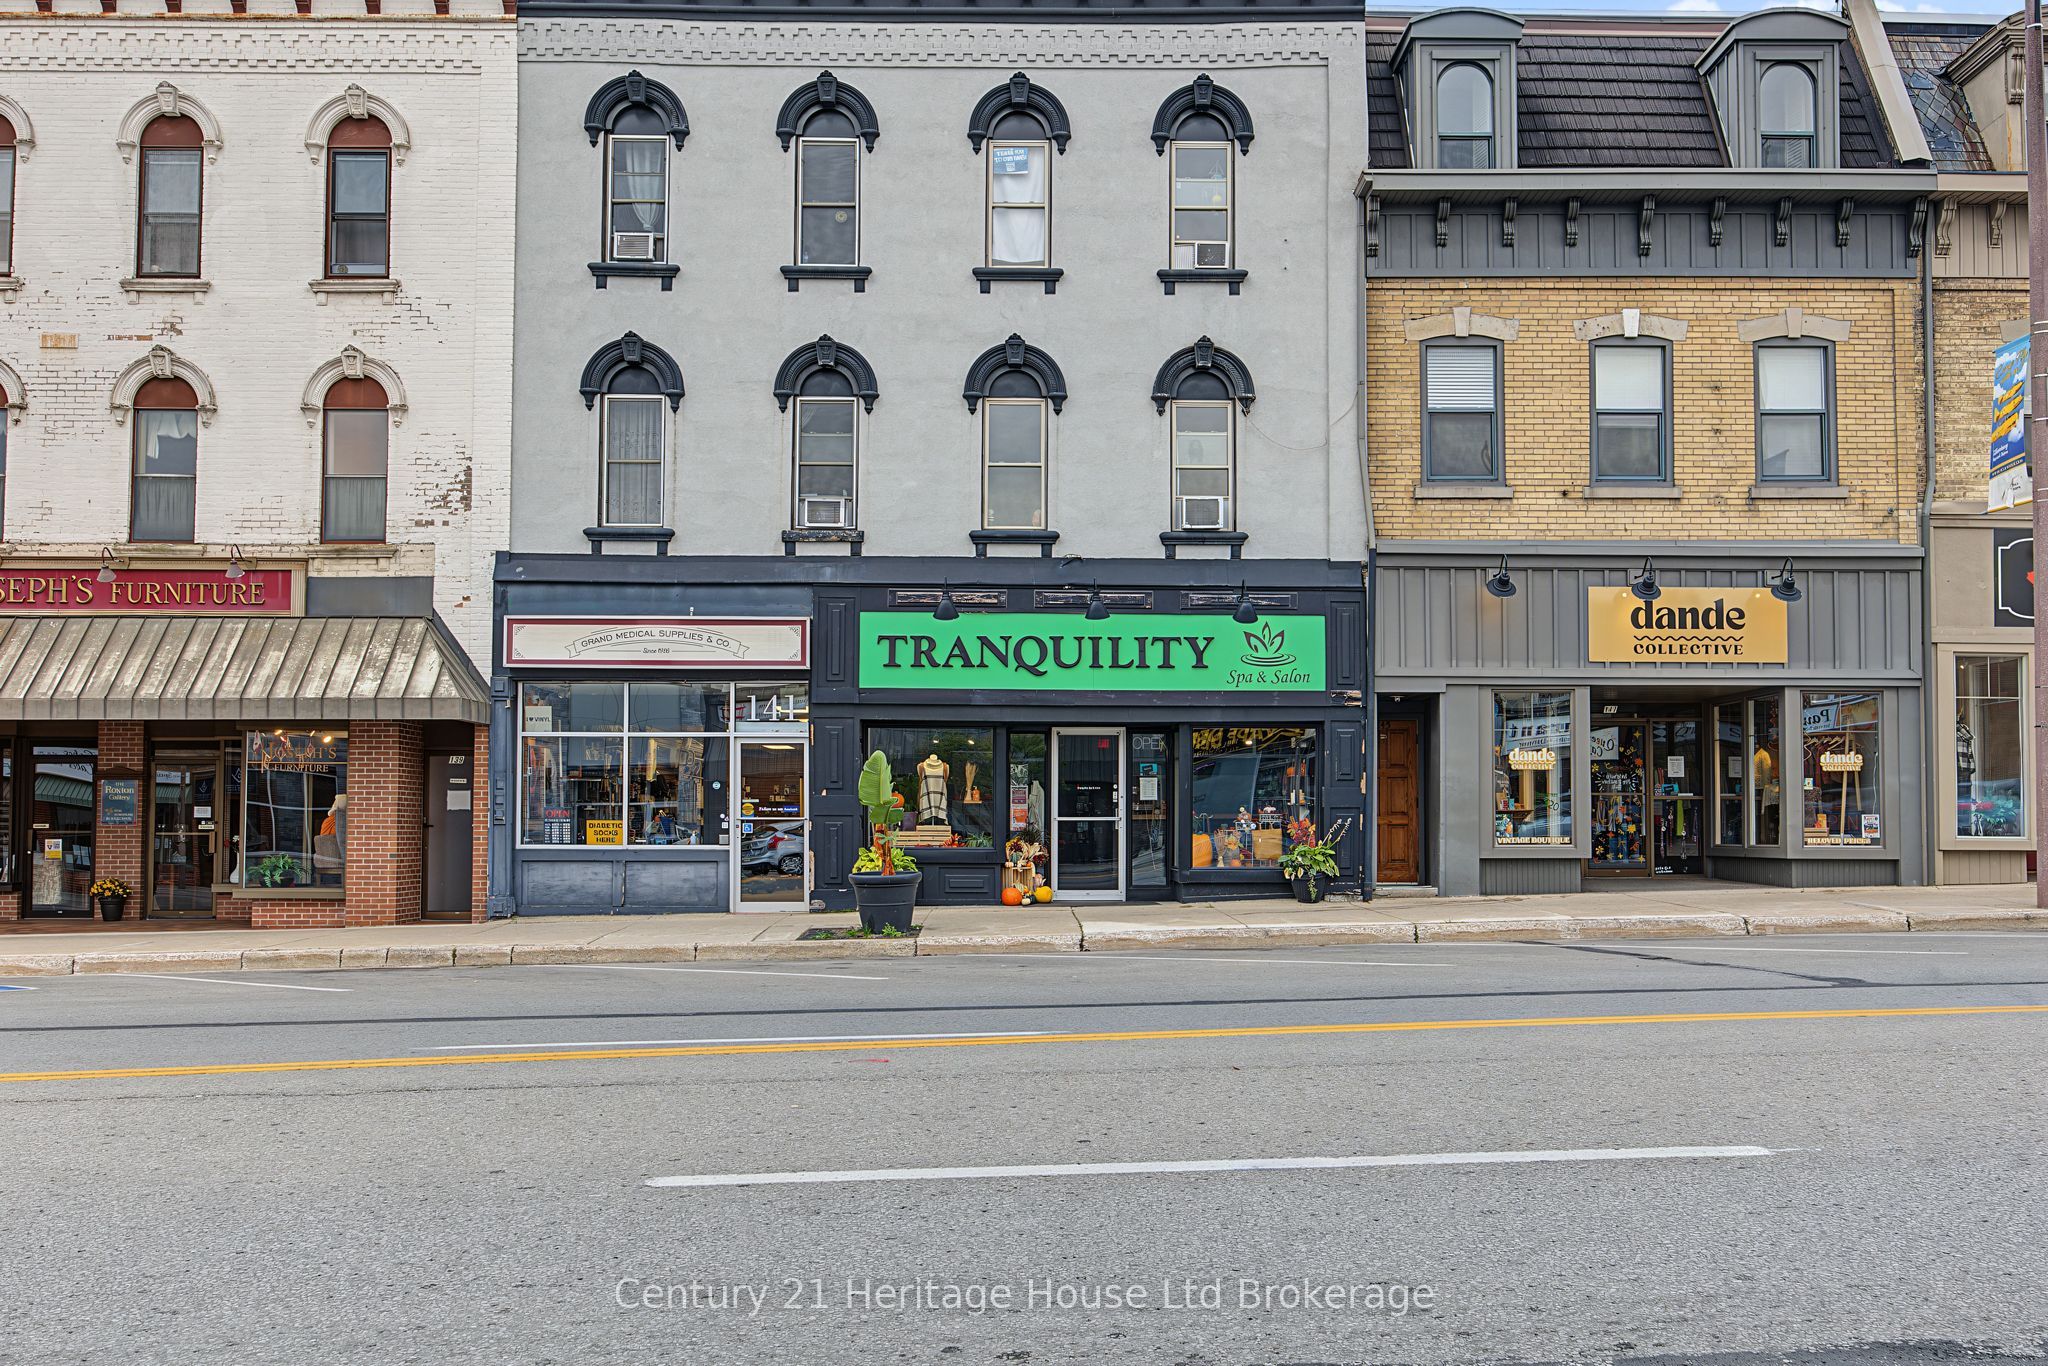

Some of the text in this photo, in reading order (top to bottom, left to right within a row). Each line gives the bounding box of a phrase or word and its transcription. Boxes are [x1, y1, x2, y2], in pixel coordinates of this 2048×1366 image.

[110, 582, 266, 605] FURNITURE
[1630, 598, 1746, 631] dande
[581, 634, 613, 647] GRAND
[616, 629, 656, 640] MEDICAL
[658, 629, 703, 641] SUPPLIES
[706, 635, 713, 643] &
[877, 634, 1215, 677] TRANQUILITY
[1633, 643, 1744, 655] COLLECTIVE
[1226, 668, 1311, 687] Spa & Salon
[747, 694, 800, 721] 141
[1509, 748, 1556, 761] dande
[1820, 751, 1863, 763] dande
[274, 764, 329, 773] FURNITURE
[1498, 836, 1571, 845] VINTAGE BOUTIQUE
